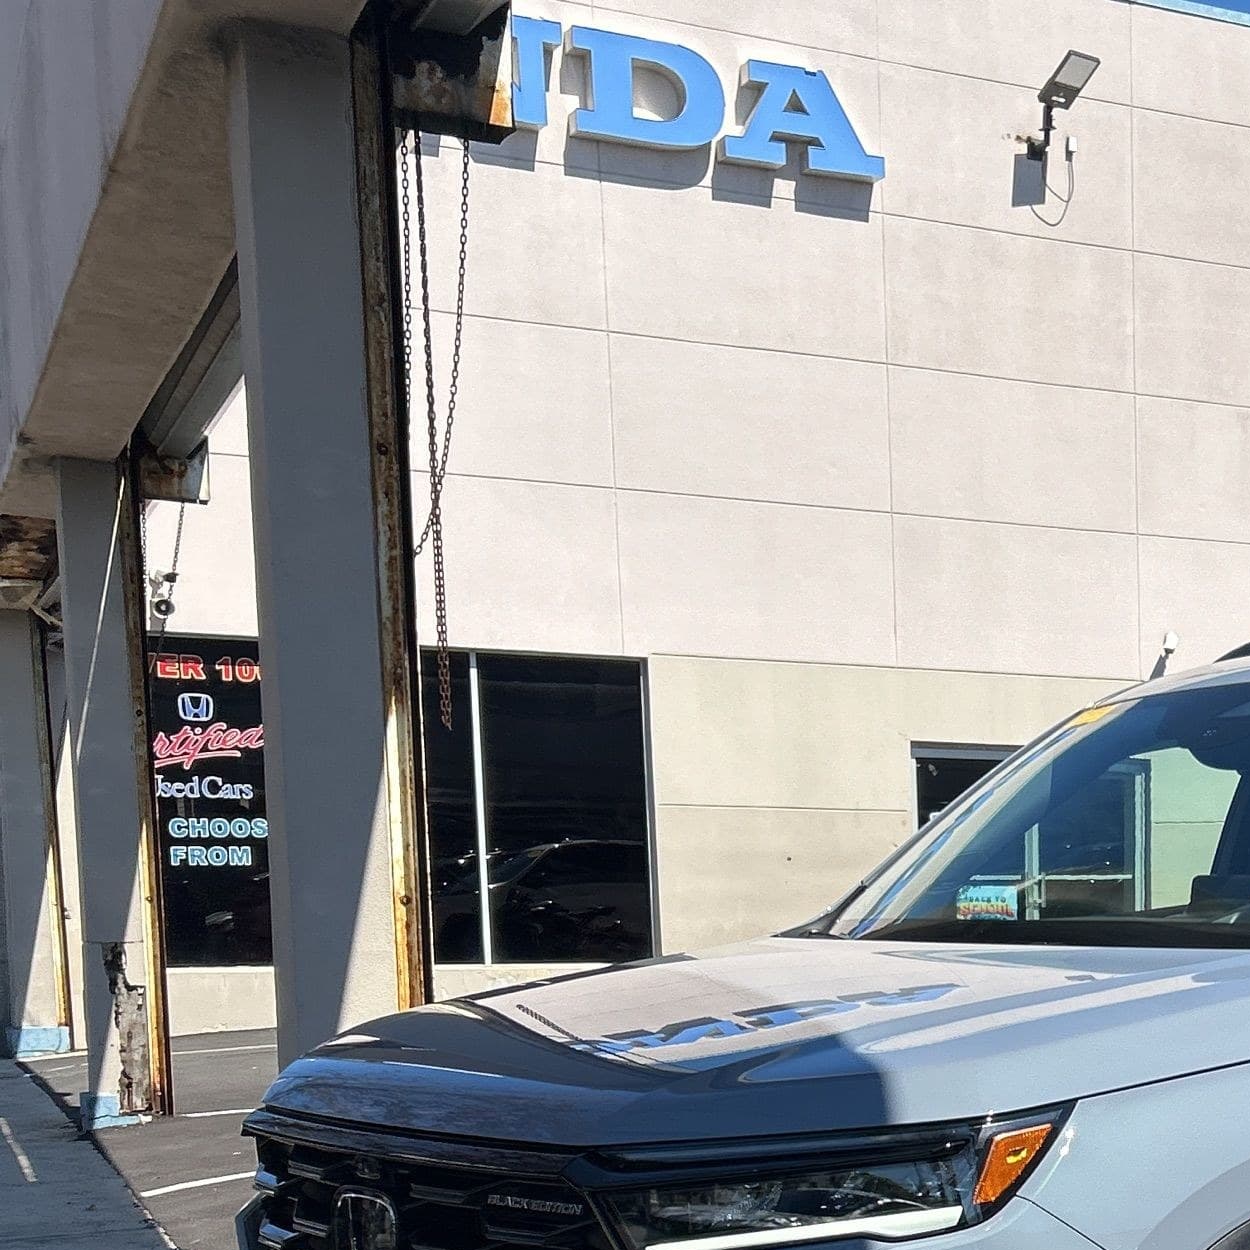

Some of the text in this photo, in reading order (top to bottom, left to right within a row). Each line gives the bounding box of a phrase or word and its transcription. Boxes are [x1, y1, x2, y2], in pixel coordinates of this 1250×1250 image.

[216, 656, 262, 682] 10
[153, 722, 265, 770] rtified
[201, 776, 254, 799] Cars
[168, 818, 269, 838] CHOOS
[169, 846, 252, 866] FROM
[487, 1194, 528, 1209] BLACK
